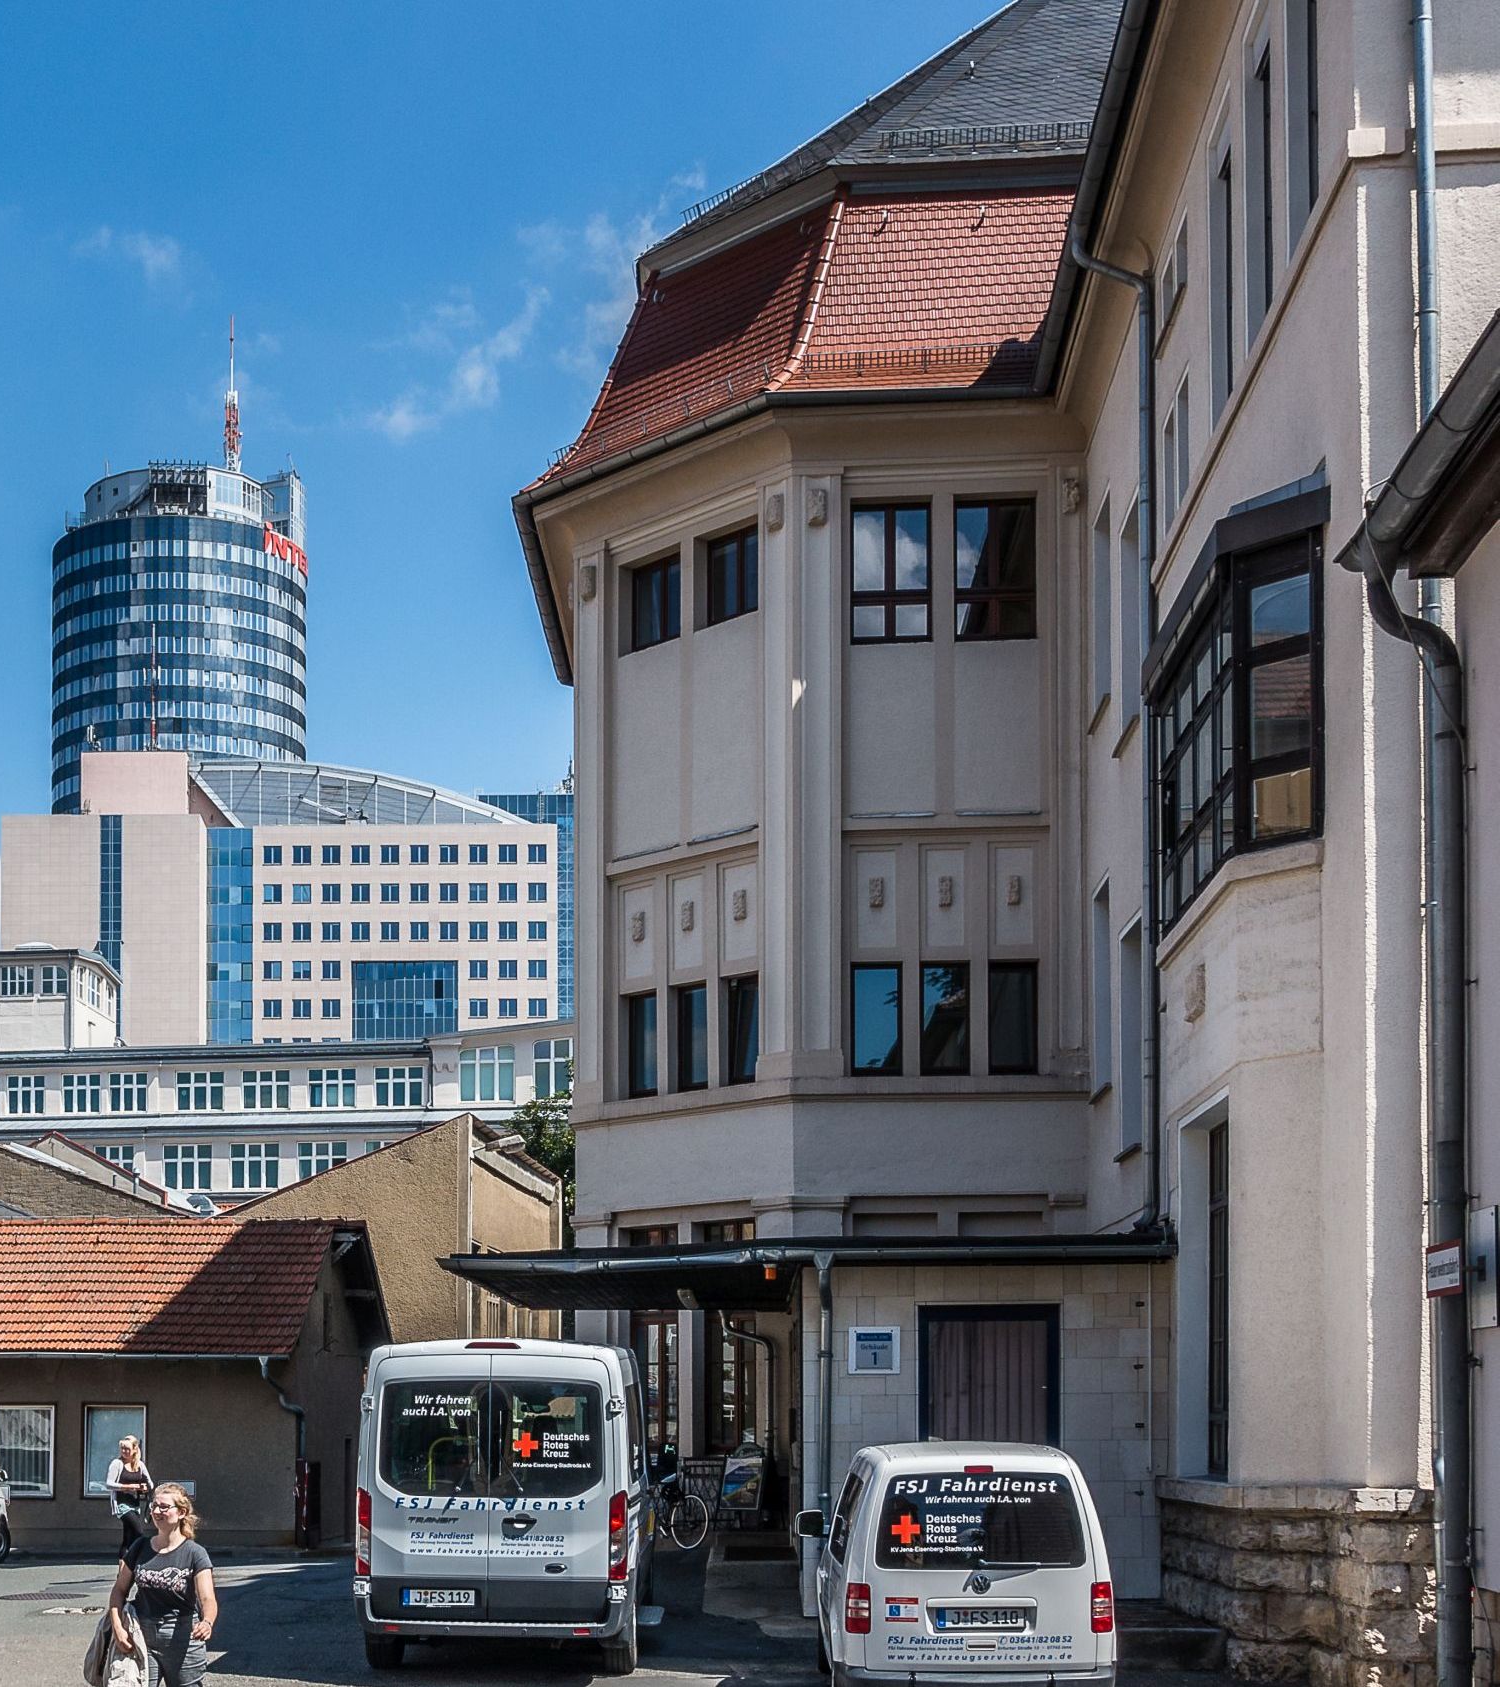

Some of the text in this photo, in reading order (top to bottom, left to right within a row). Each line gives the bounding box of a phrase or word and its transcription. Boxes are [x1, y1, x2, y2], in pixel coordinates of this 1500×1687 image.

[871, 1351, 877, 1365] 1
[414, 1394, 472, 1405] Wir fahren
[402, 1406, 471, 1416] auch i.A. von
[543, 1432, 590, 1441] Deutsches
[543, 1441, 570, 1449] Rotes
[543, 1450, 570, 1458] Kreuz
[894, 1477, 1058, 1495] FSJ Fahrdienst
[395, 1497, 586, 1512] FSJ Fahrdienst
[925, 1496, 942, 1504] Wir
[943, 1495, 973, 1504] fahren
[974, 1495, 996, 1503] auch
[997, 1495, 1012, 1503] i.A.
[925, 1514, 982, 1523] Deutsches
[926, 1524, 957, 1533] Rotes
[410, 1531, 475, 1540] FSJ Fahrdienst
[555, 1535, 565, 1543] 52
[926, 1533, 957, 1543] Kreuz
[409, 1547, 565, 1557] www.fahrzeugservice-jena.de
[899, 1545, 972, 1553] Jena-Eisenberg-Stadtroda
[414, 1591, 470, 1603] J FS 119
[951, 1610, 1019, 1625] J FS 110
[887, 1635, 1073, 1645] FSJ Fahrdienst 03641/82 08 52
[887, 1652, 1072, 1662] www.fahrzeugservice-jena.de
